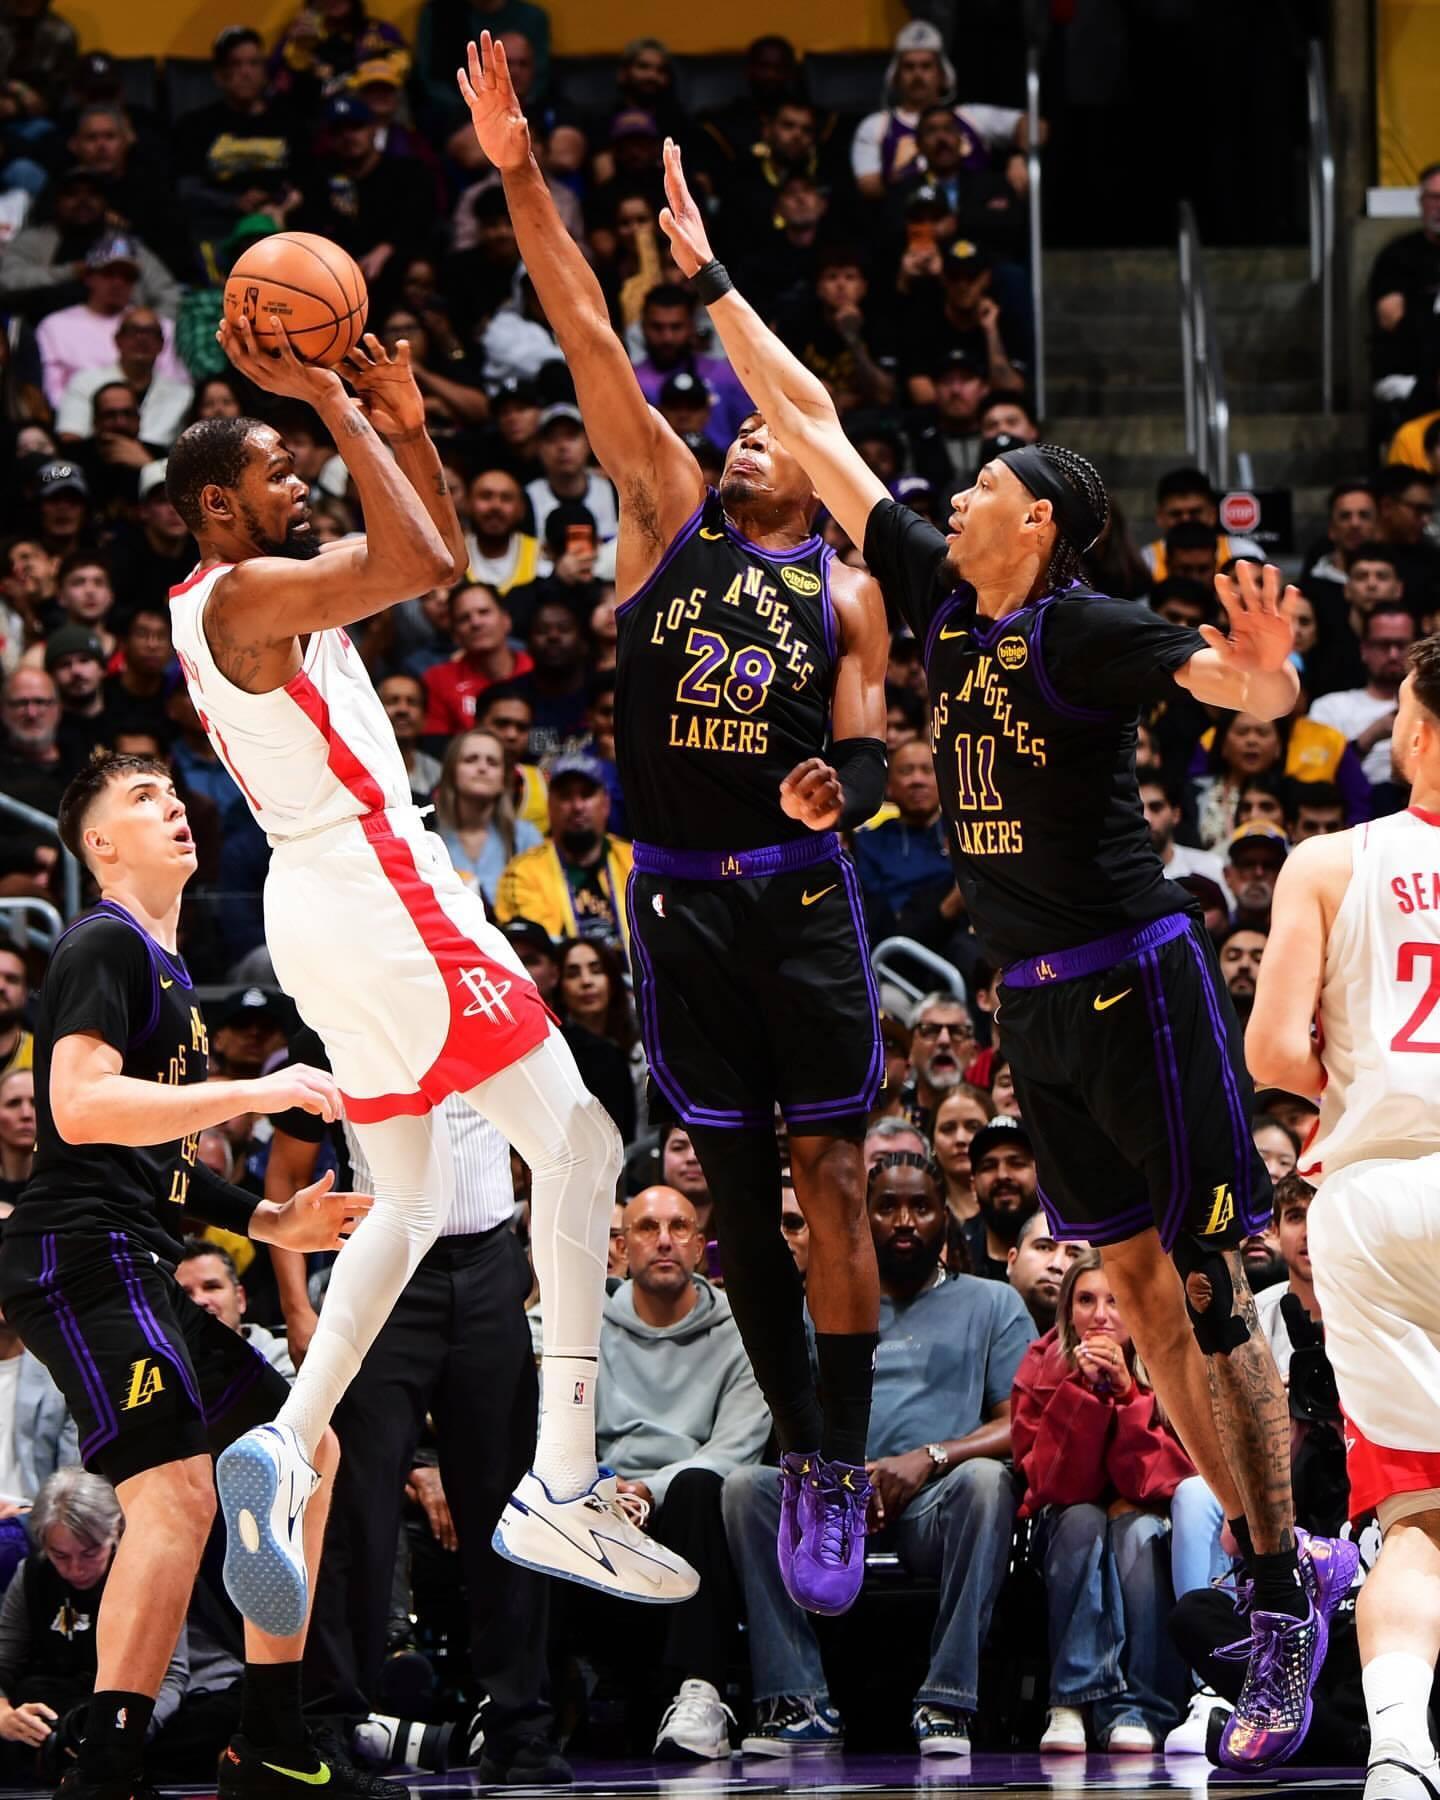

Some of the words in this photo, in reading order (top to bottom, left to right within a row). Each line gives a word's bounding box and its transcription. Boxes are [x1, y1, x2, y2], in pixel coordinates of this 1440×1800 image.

[651, 587, 707, 645] LOS
[723, 566, 814, 692] ANGELES
[676, 627, 776, 715] 28
[1000, 645, 1026, 660] bibigo
[956, 656, 1047, 767] ANGELES
[669, 714, 769, 754] LAKERS
[955, 733, 1003, 811] 11
[955, 820, 1023, 855] LAKERS
[721, 855, 743, 876] LAL
[1036, 959, 1057, 981] LAL
